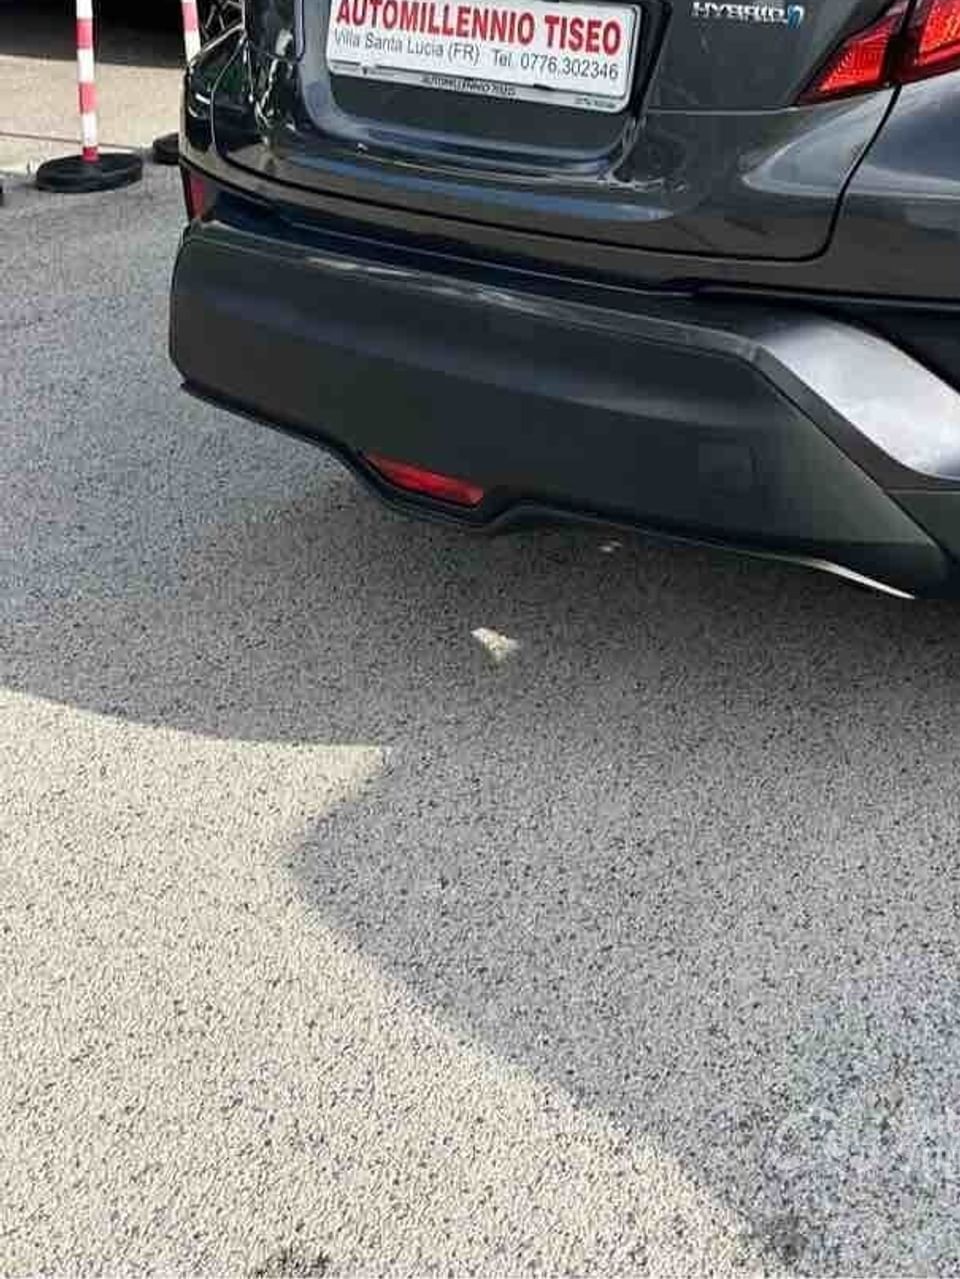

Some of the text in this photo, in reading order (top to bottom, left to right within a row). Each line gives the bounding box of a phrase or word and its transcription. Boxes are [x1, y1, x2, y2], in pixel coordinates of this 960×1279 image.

[692, 1, 785, 22] HYBRID
[334, 28, 360, 48] Villa
[365, 32, 403, 54] Santa
[408, 39, 444, 57] Lucia
[447, 42, 480, 64] (FR)
[520, 52, 619, 81] 0776.302346
[544, 14, 621, 56] TISEO
